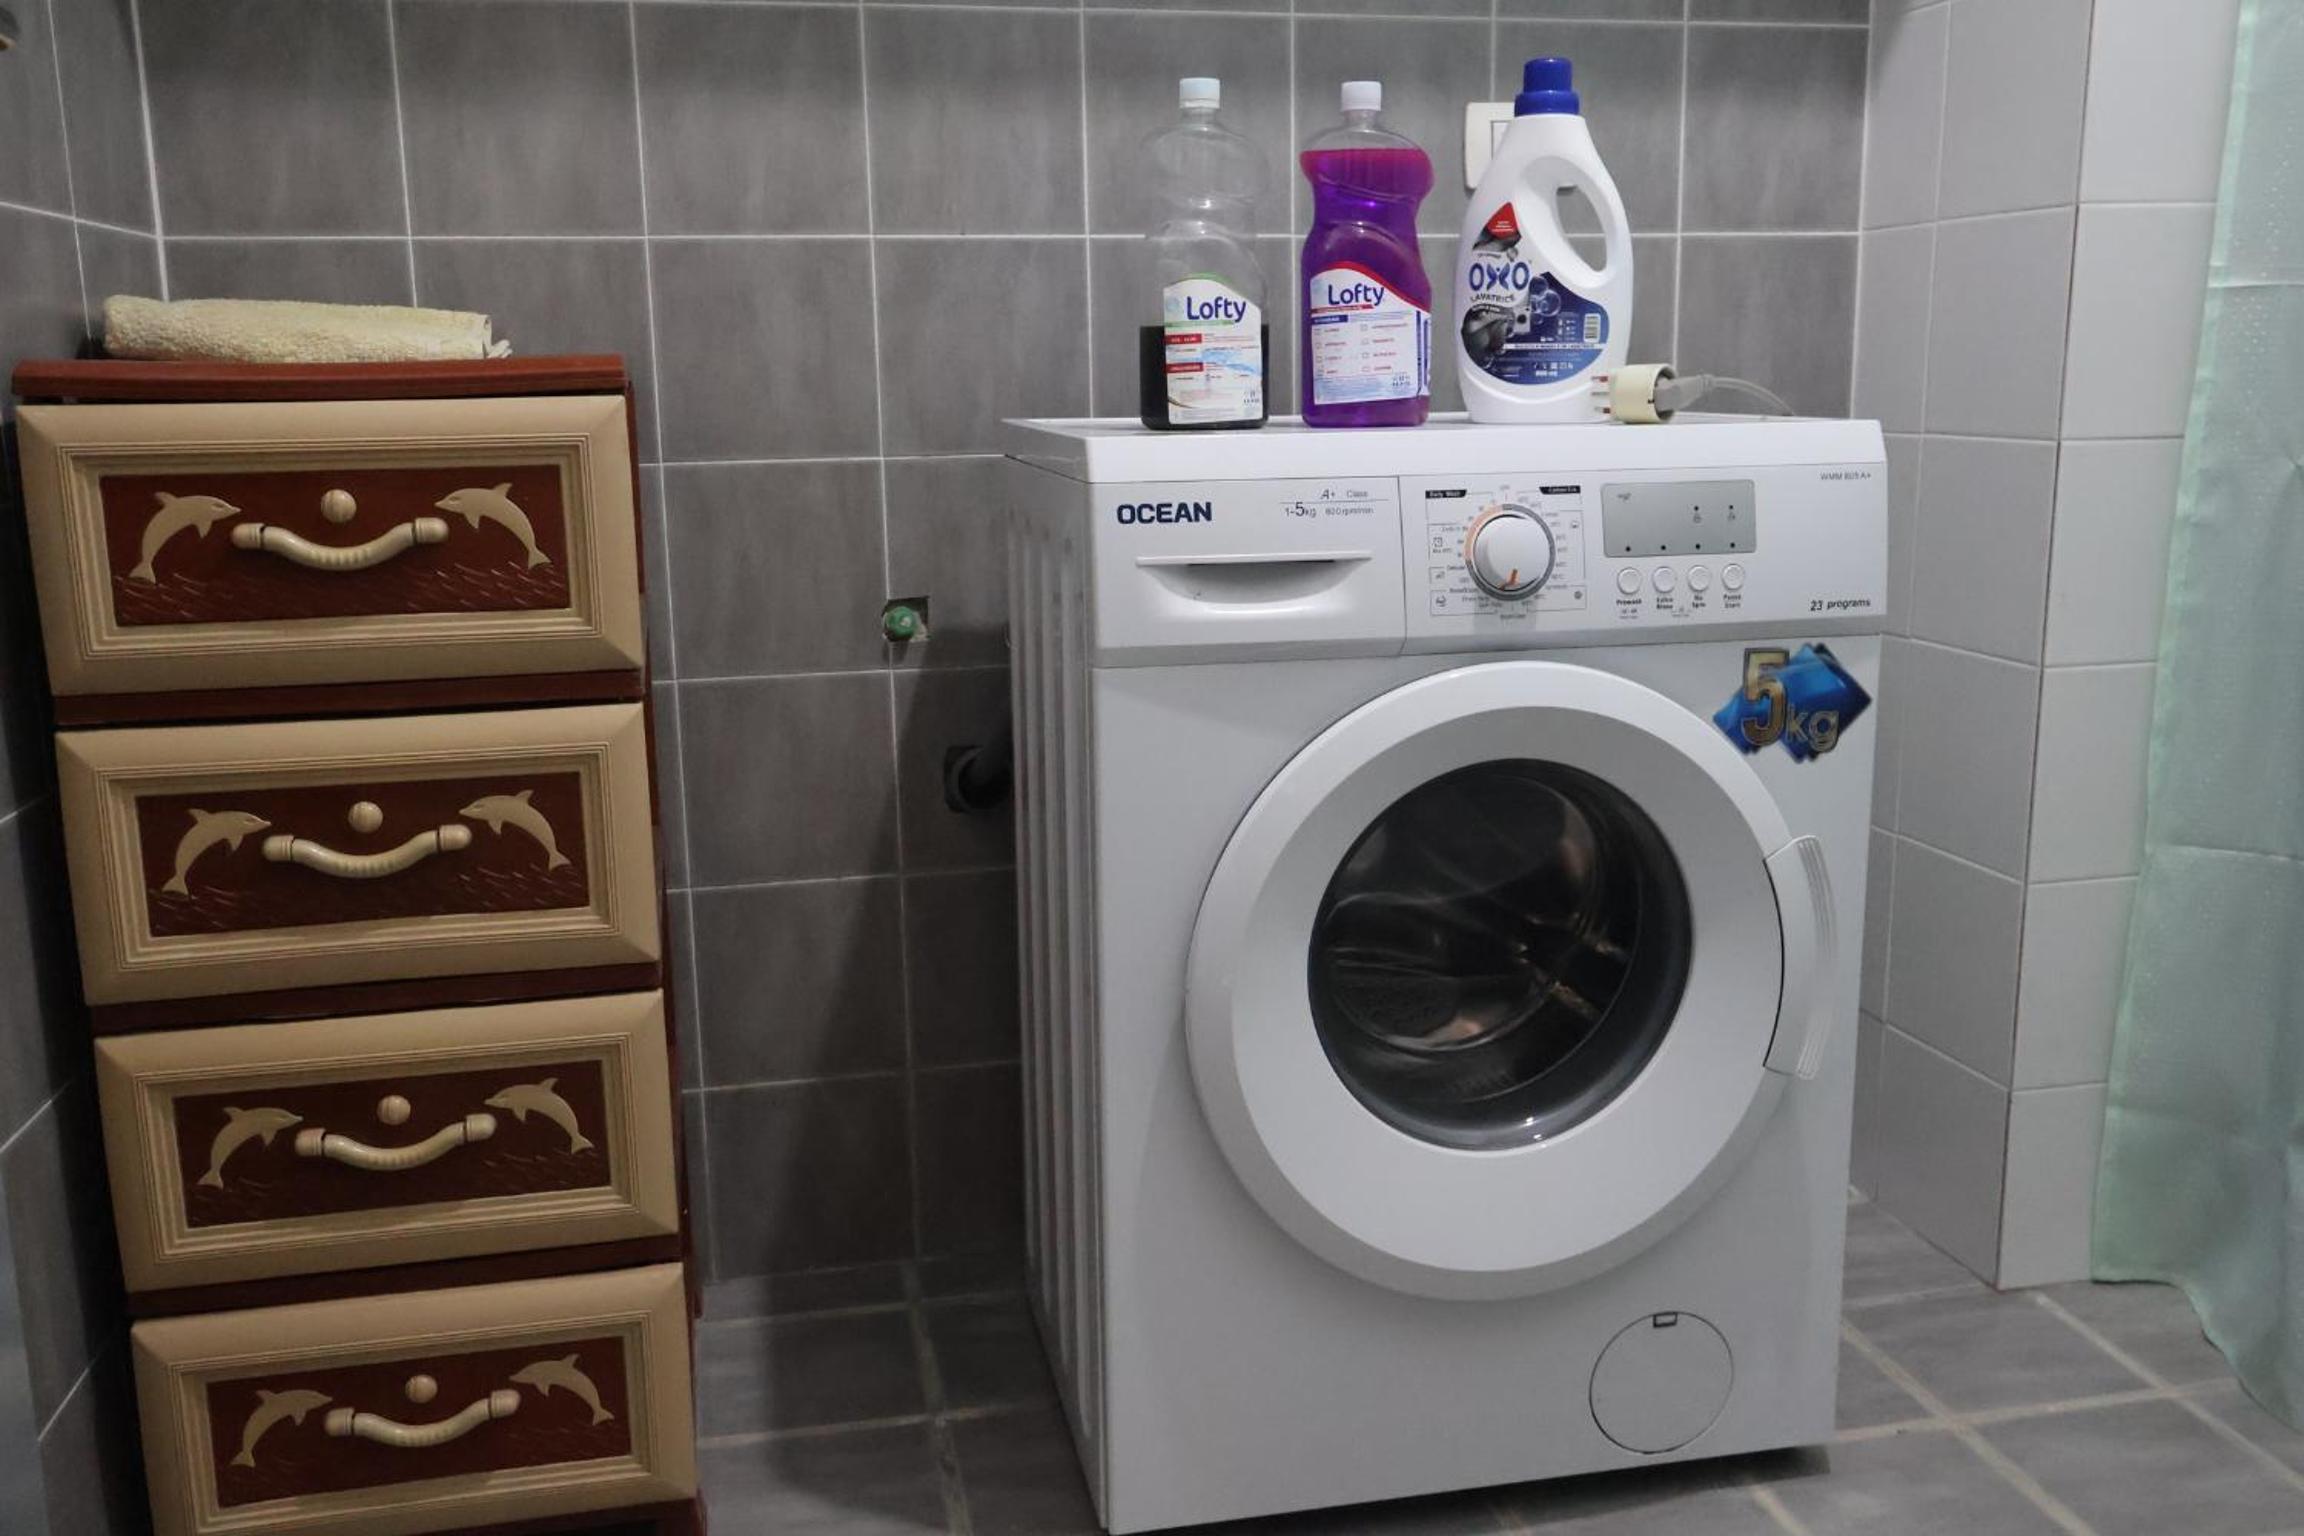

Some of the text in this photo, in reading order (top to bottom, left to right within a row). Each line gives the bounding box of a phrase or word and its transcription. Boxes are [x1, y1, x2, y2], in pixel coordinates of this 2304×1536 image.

[1469, 261, 1530, 291] OXO
[1327, 283, 1385, 306] Lofty
[1186, 296, 1247, 322] Lofty
[1116, 502, 1212, 525] OCEAN
[1810, 598, 1871, 611] 23 programs
[1741, 648, 1840, 753] 5kg
